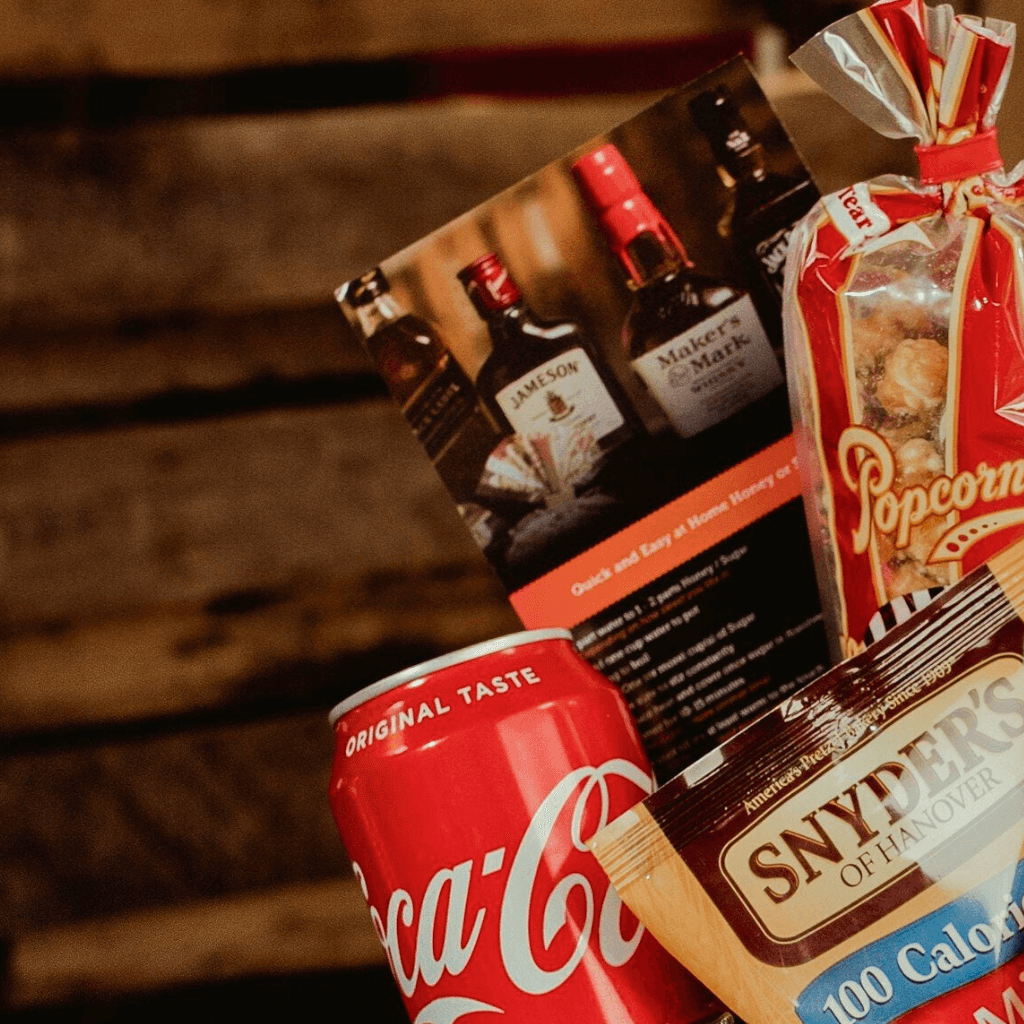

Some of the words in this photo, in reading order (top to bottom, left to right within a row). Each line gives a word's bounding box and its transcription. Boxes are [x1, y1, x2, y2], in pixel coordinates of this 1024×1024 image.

[656, 313, 741, 370] Maker's
[690, 334, 752, 376] Mark
[510, 360, 579, 410] JAMESON
[570, 566, 612, 596] Quick
[611, 550, 639, 571] and
[639, 531, 673, 557] Easy
[687, 500, 727, 527] Home
[729, 474, 775, 504] Honey
[345, 697, 451, 757] ORIGINAL
[457, 666, 541, 704] TASTE
[741, 765, 802, 813] America's
[839, 856, 877, 889] OF
[878, 768, 998, 859] HANOVER
